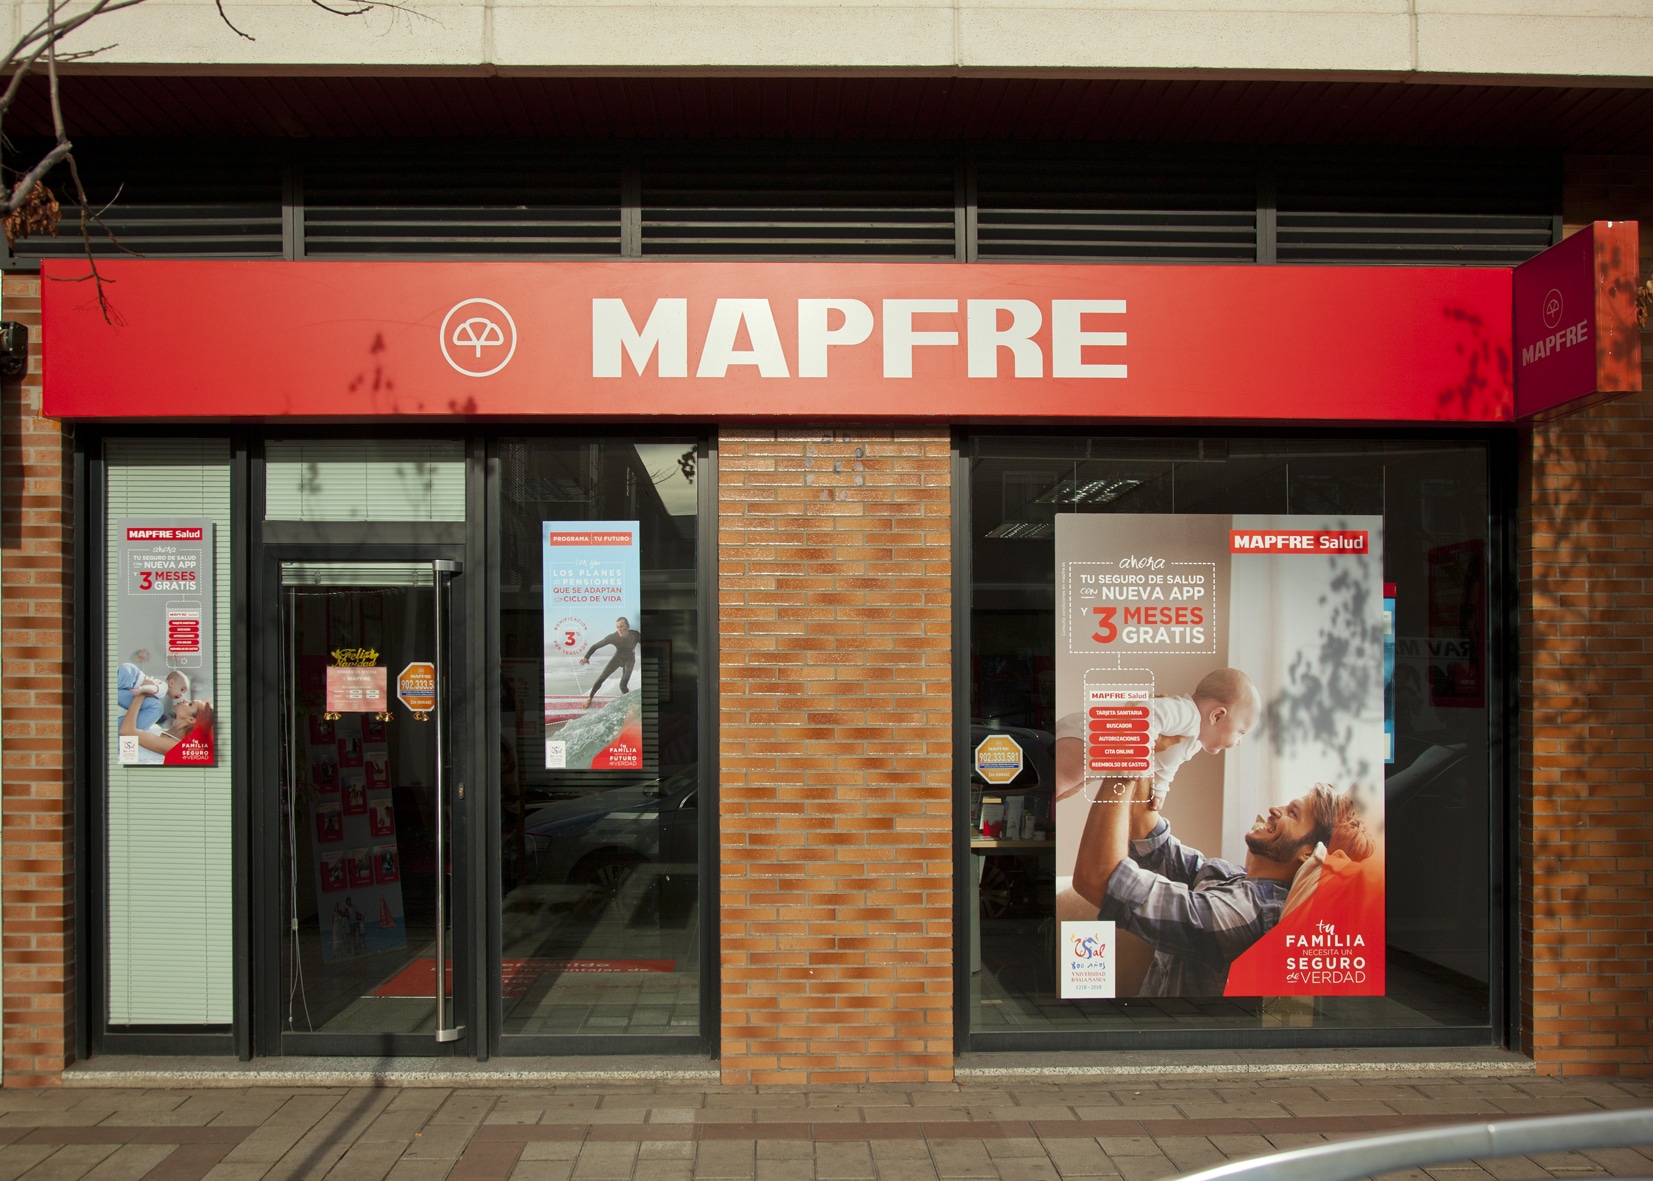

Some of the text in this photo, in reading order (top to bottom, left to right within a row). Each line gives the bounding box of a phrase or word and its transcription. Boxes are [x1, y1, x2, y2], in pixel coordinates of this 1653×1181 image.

[592, 298, 1128, 378] MAPFRE
[1522, 319, 1588, 367] MAPFRE
[129, 530, 200, 538] MAPFRE Salud
[1234, 535, 1364, 549] MAPFRE Salud
[1118, 555, 1166, 571] ahora
[553, 569, 623, 577] LOS PLANES
[1080, 575, 1205, 584] TU SEGURO DE SALUD
[139, 571, 153, 590] 3
[155, 571, 196, 580] MESES
[154, 581, 197, 590] GRATIS
[564, 595, 588, 603] CICLO
[590, 595, 600, 603] DE
[603, 595, 622, 603] VIDA
[1080, 586, 1205, 600] con NUEVA APP
[1080, 606, 1204, 644] Y 3 MESES
[1122, 626, 1205, 644] GRATIS
[979, 752, 1019, 762] 902.333.581
[1316, 919, 1335, 935] tu
[1286, 934, 1366, 947] FAMILIA
[1286, 957, 1366, 970] SEGURO
[1286, 971, 1366, 984] de VERDAD
